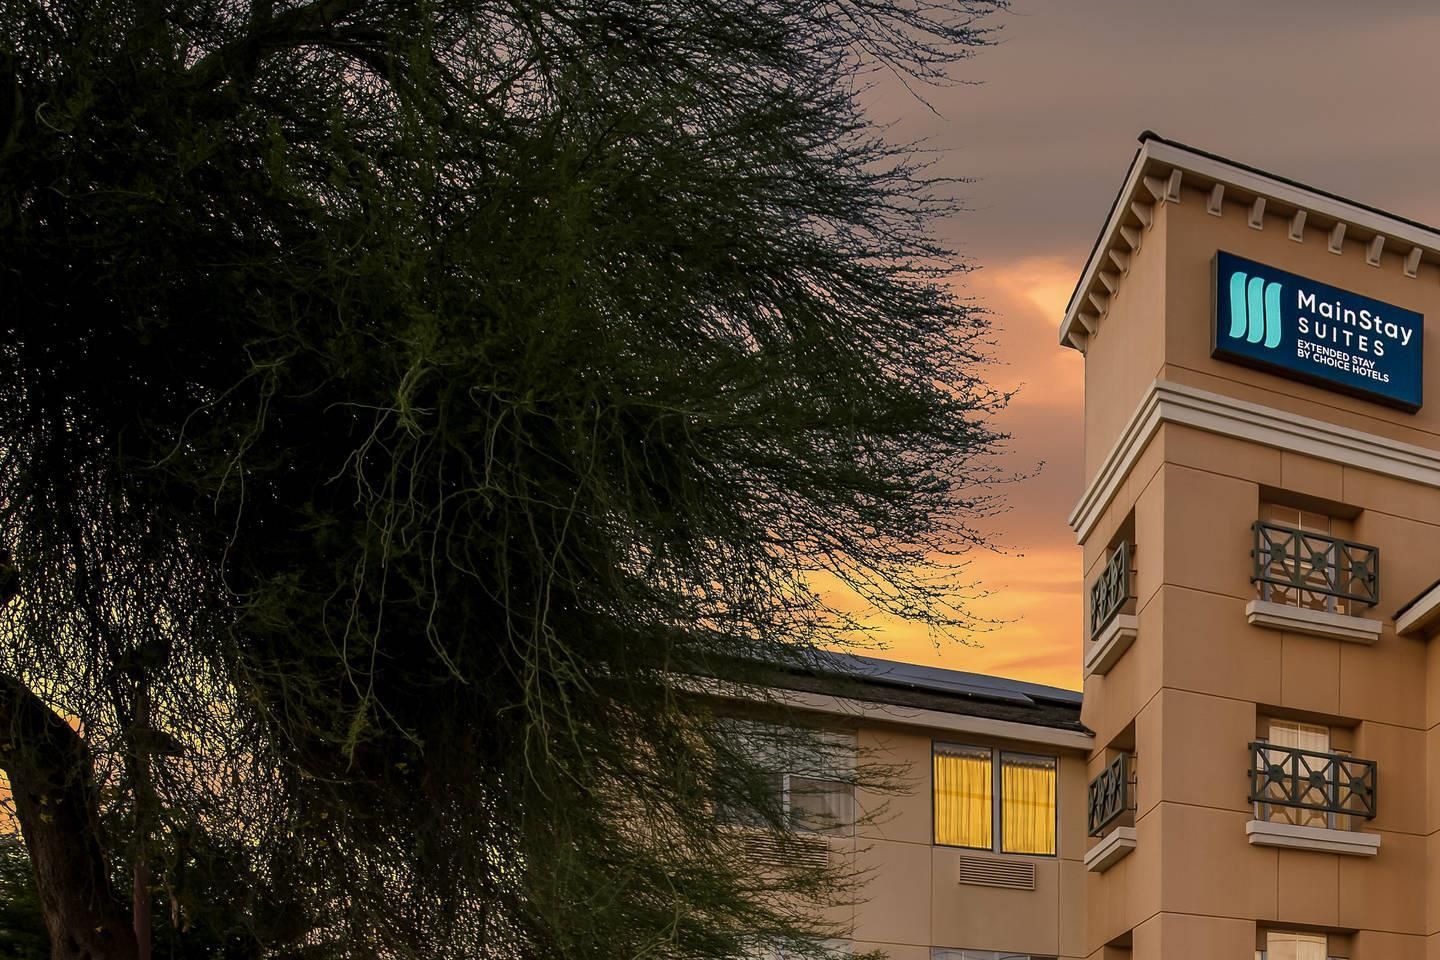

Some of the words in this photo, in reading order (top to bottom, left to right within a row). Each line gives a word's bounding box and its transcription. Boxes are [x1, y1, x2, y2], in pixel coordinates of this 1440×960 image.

[1297, 289, 1413, 346] MainStay
[1297, 339, 1350, 362] EXTENDED
[1351, 355, 1376, 370] STAY
[1298, 317, 1385, 356] SUITES
[1297, 348, 1311, 360] BY
[1312, 353, 1350, 371] CHOICE
[1352, 364, 1390, 383] HOTELS
